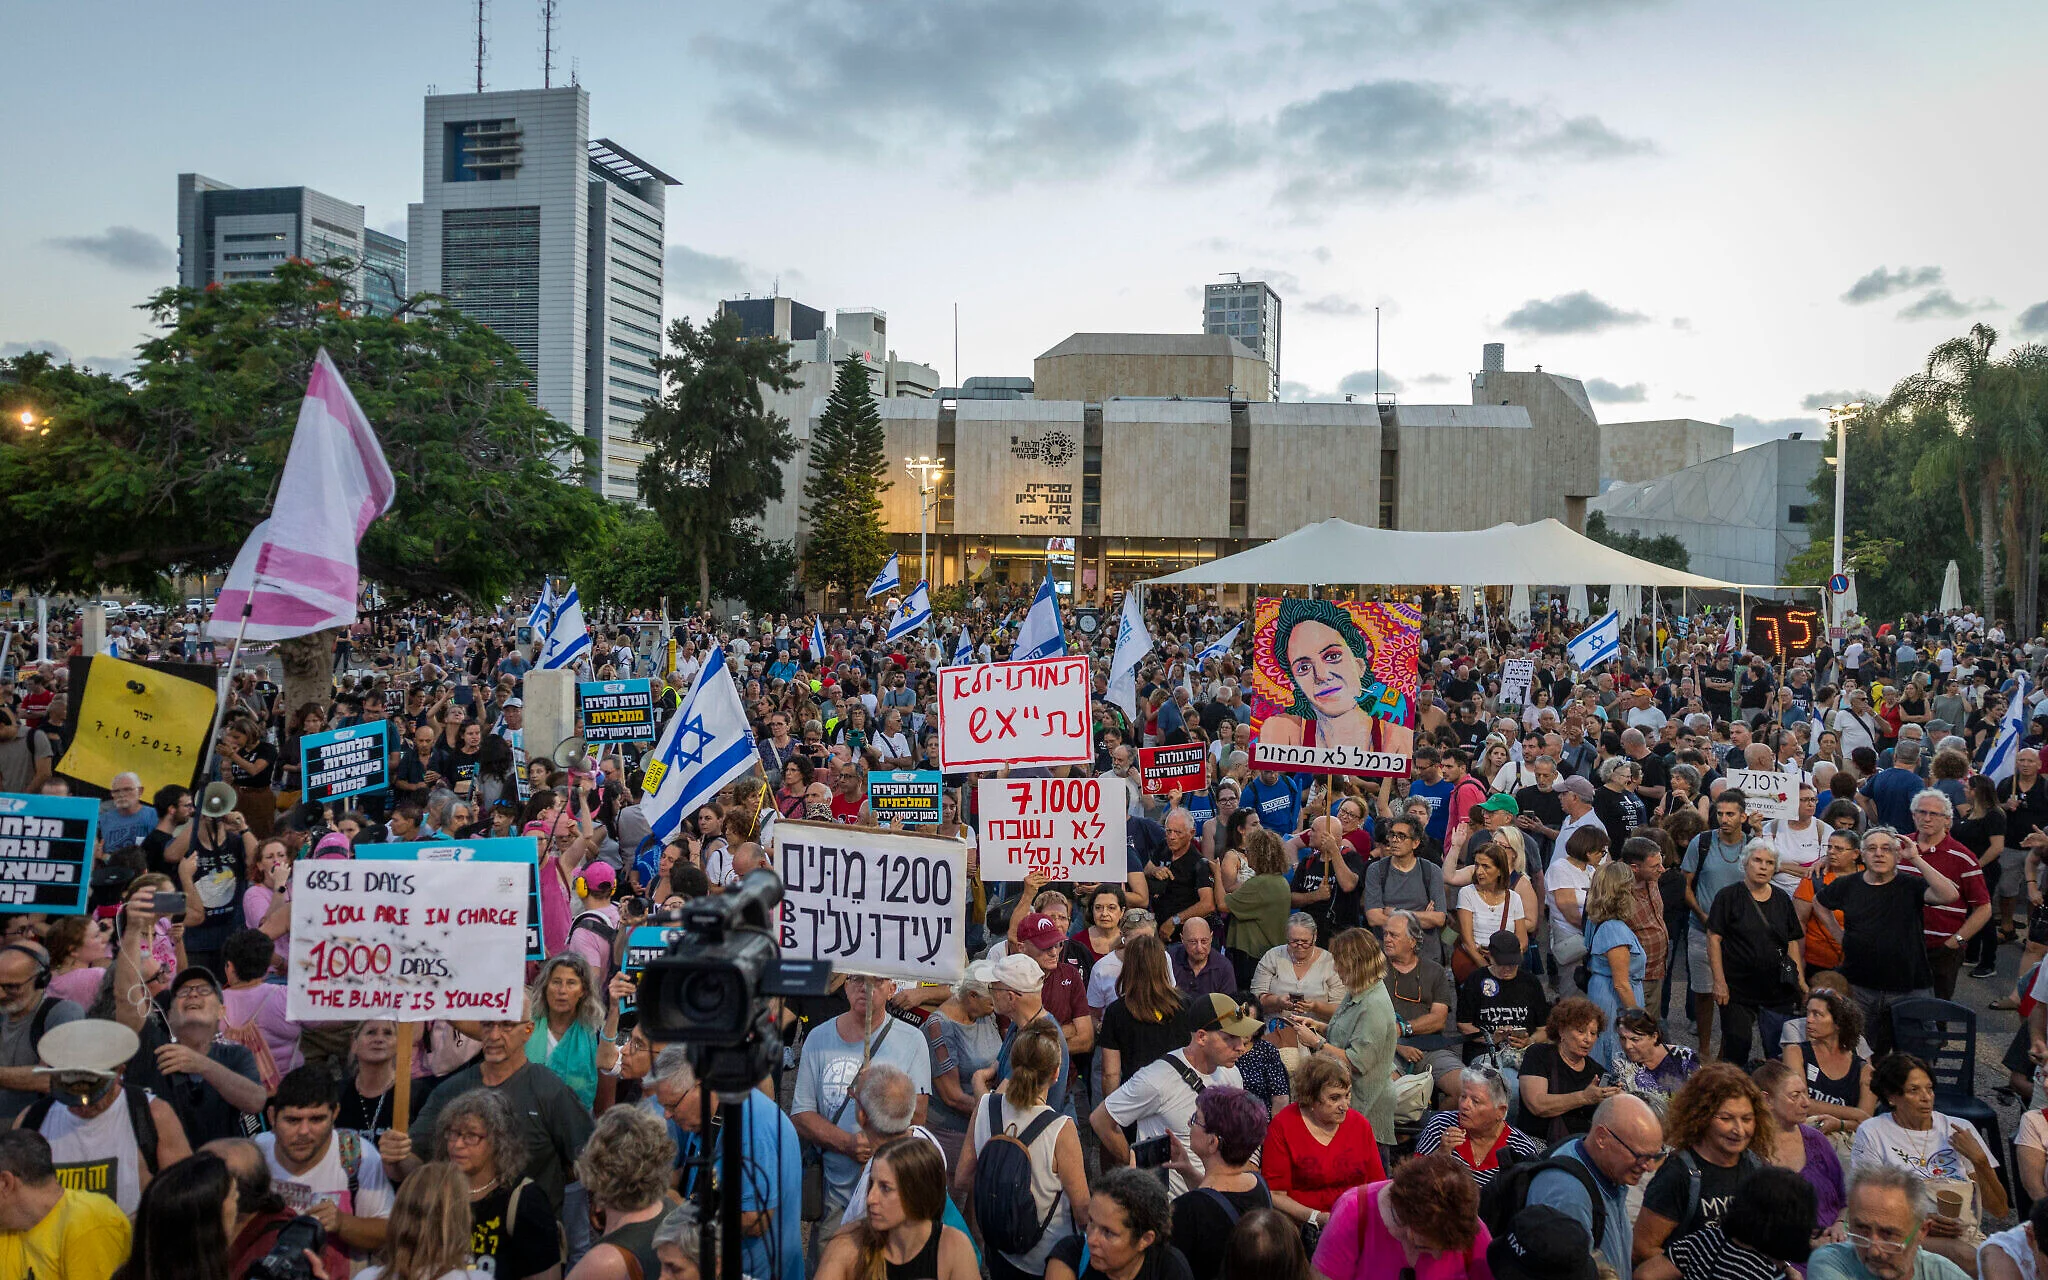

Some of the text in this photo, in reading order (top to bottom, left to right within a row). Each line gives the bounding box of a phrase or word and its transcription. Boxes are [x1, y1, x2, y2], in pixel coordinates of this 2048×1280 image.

[1026, 484, 1072, 493] ספריית
[1048, 504, 1072, 514] בית
[1020, 514, 1071, 524] אריאלה
[585, 694, 648, 709] ועדת חקירה
[134, 710, 153, 720] זכור
[592, 710, 644, 724] ממלכתית
[96, 720, 182, 757] 7.10.2023
[608, 726, 632, 740] ביטחון
[634, 724, 652, 738] למען
[320, 736, 374, 758] מלחמות
[1185, 748, 1202, 760] תהיו
[1258, 746, 1315, 764] תחזור
[1322, 746, 1346, 765] לא
[324, 750, 369, 770] נגמרות
[310, 760, 382, 786] כשאימהות
[1144, 764, 1200, 778] קחו אחריות!
[872, 784, 937, 796] ועדת חקירה
[1006, 779, 1100, 815] 7.1000
[879, 796, 930, 808] ממלכתית
[920, 810, 938, 822] למען
[988, 812, 1106, 841] לא נשכח
[1008, 842, 1104, 866] ולא נסלח
[306, 870, 416, 895] 6851 DAYS
[876, 854, 952, 906] 1200
[322, 904, 518, 926] YOU ARE IN CHARGE
[800, 898, 862, 960] עליך
[308, 940, 392, 982] 1000
[307, 987, 511, 1014] THE BLAME IS YOURS!
